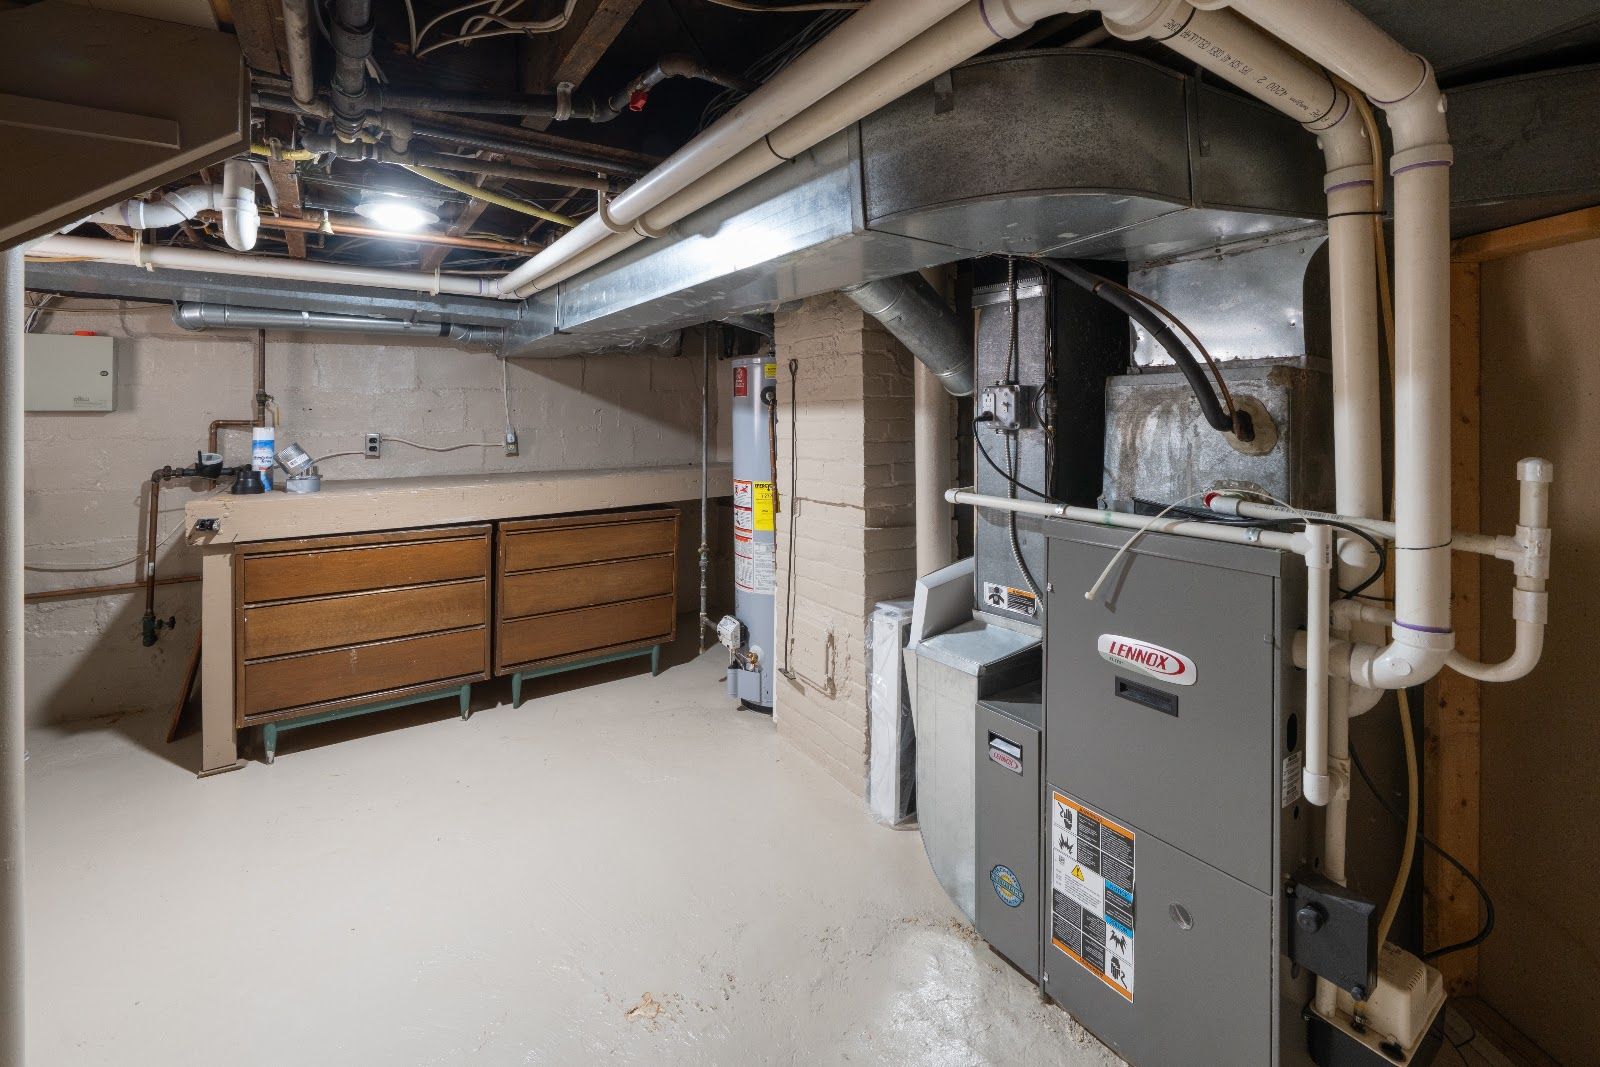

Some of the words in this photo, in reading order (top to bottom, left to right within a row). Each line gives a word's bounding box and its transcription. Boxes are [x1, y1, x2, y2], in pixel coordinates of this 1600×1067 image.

[1266, 82, 1288, 97] 4200
[1109, 641, 1169, 671] LENNOX
[993, 751, 1013, 767] LENNOX
